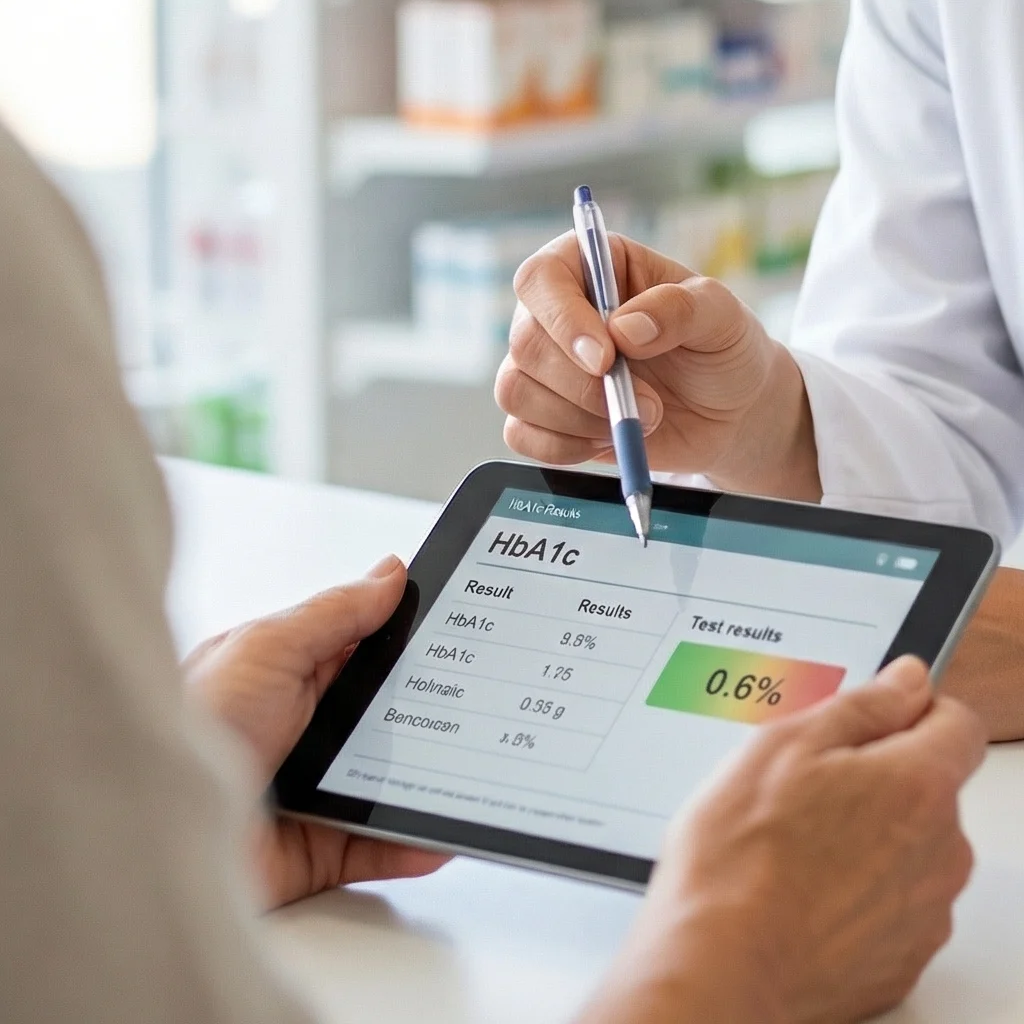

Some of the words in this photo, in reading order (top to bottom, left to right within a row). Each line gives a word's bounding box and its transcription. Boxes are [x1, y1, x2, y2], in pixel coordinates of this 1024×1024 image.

[488, 531, 580, 566] HbA1c
[464, 579, 514, 600] Result
[578, 598, 632, 620] Results
[445, 611, 495, 632] HbA1c
[691, 615, 724, 634] Test
[726, 622, 783, 643] results
[425, 643, 476, 664] HbA1c
[705, 669, 785, 706] 0.6%
